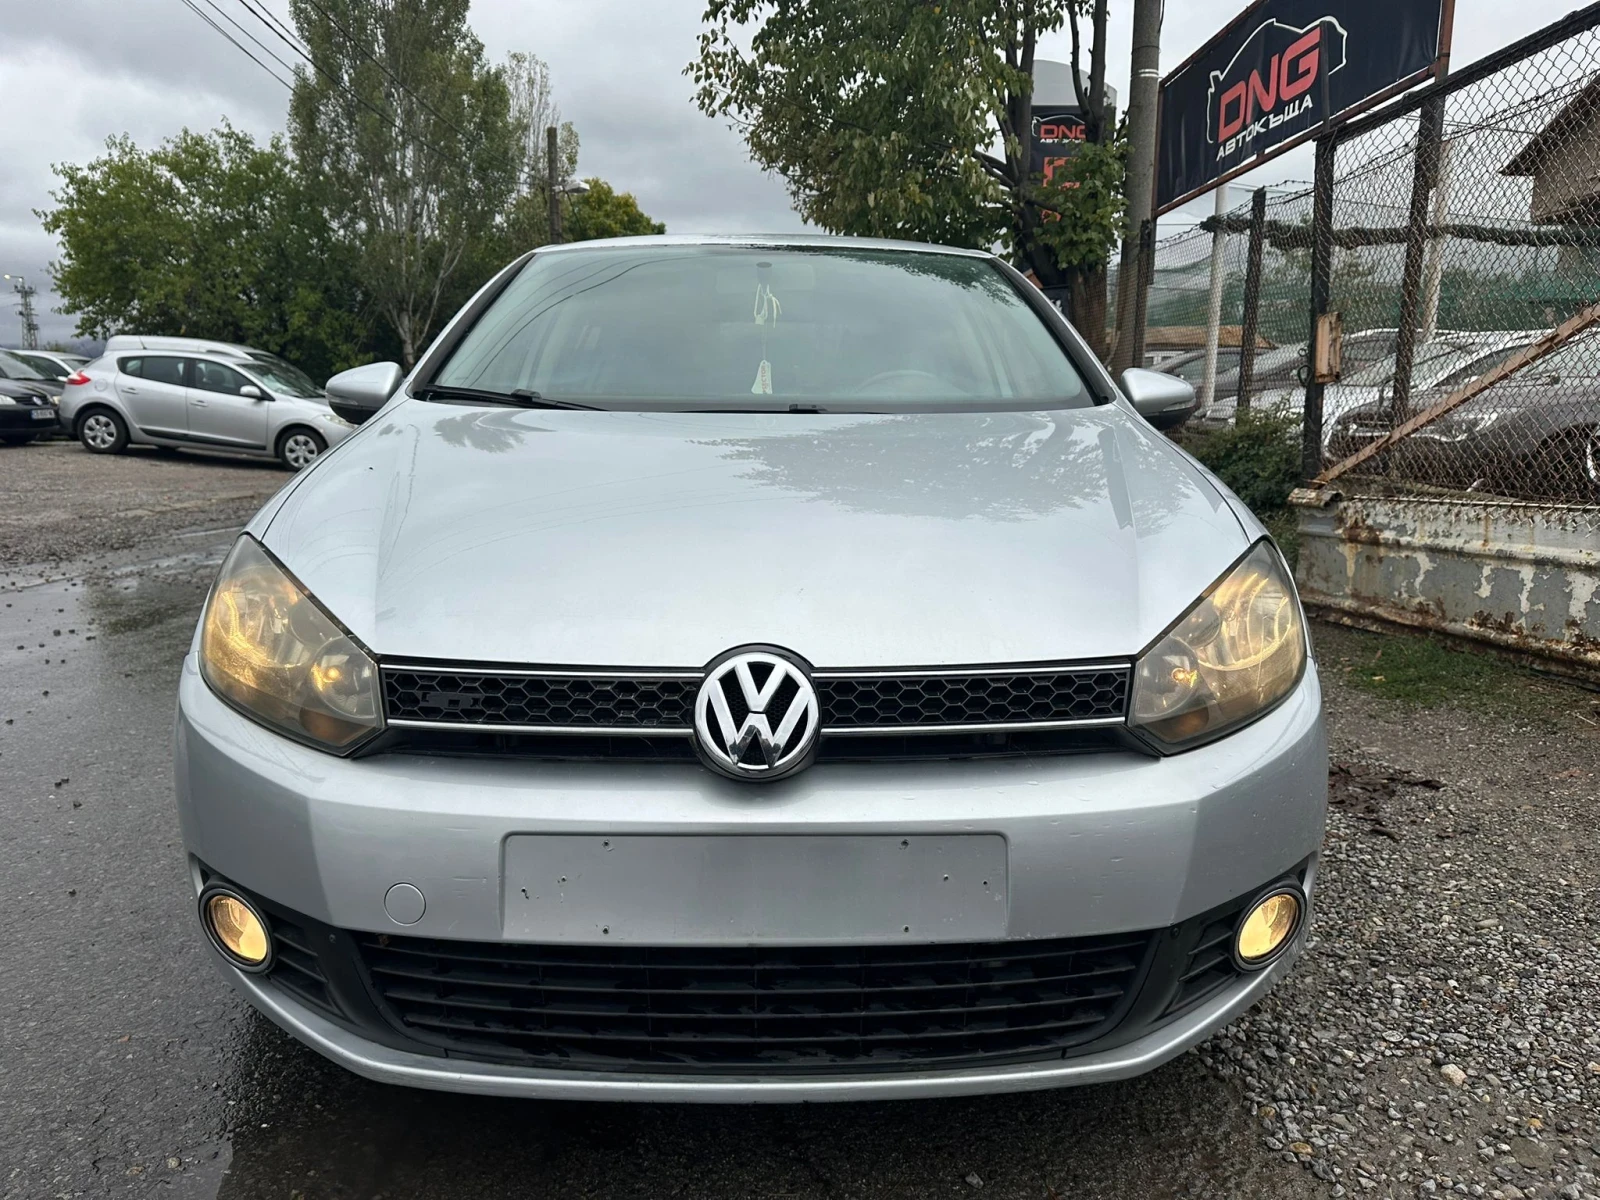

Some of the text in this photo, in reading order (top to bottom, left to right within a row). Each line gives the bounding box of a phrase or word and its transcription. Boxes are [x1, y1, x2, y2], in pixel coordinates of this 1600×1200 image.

[1216, 94, 1313, 162] АВТОКЪЩА
[1217, 26, 1321, 143] DNG
[697, 653, 818, 769] VW
